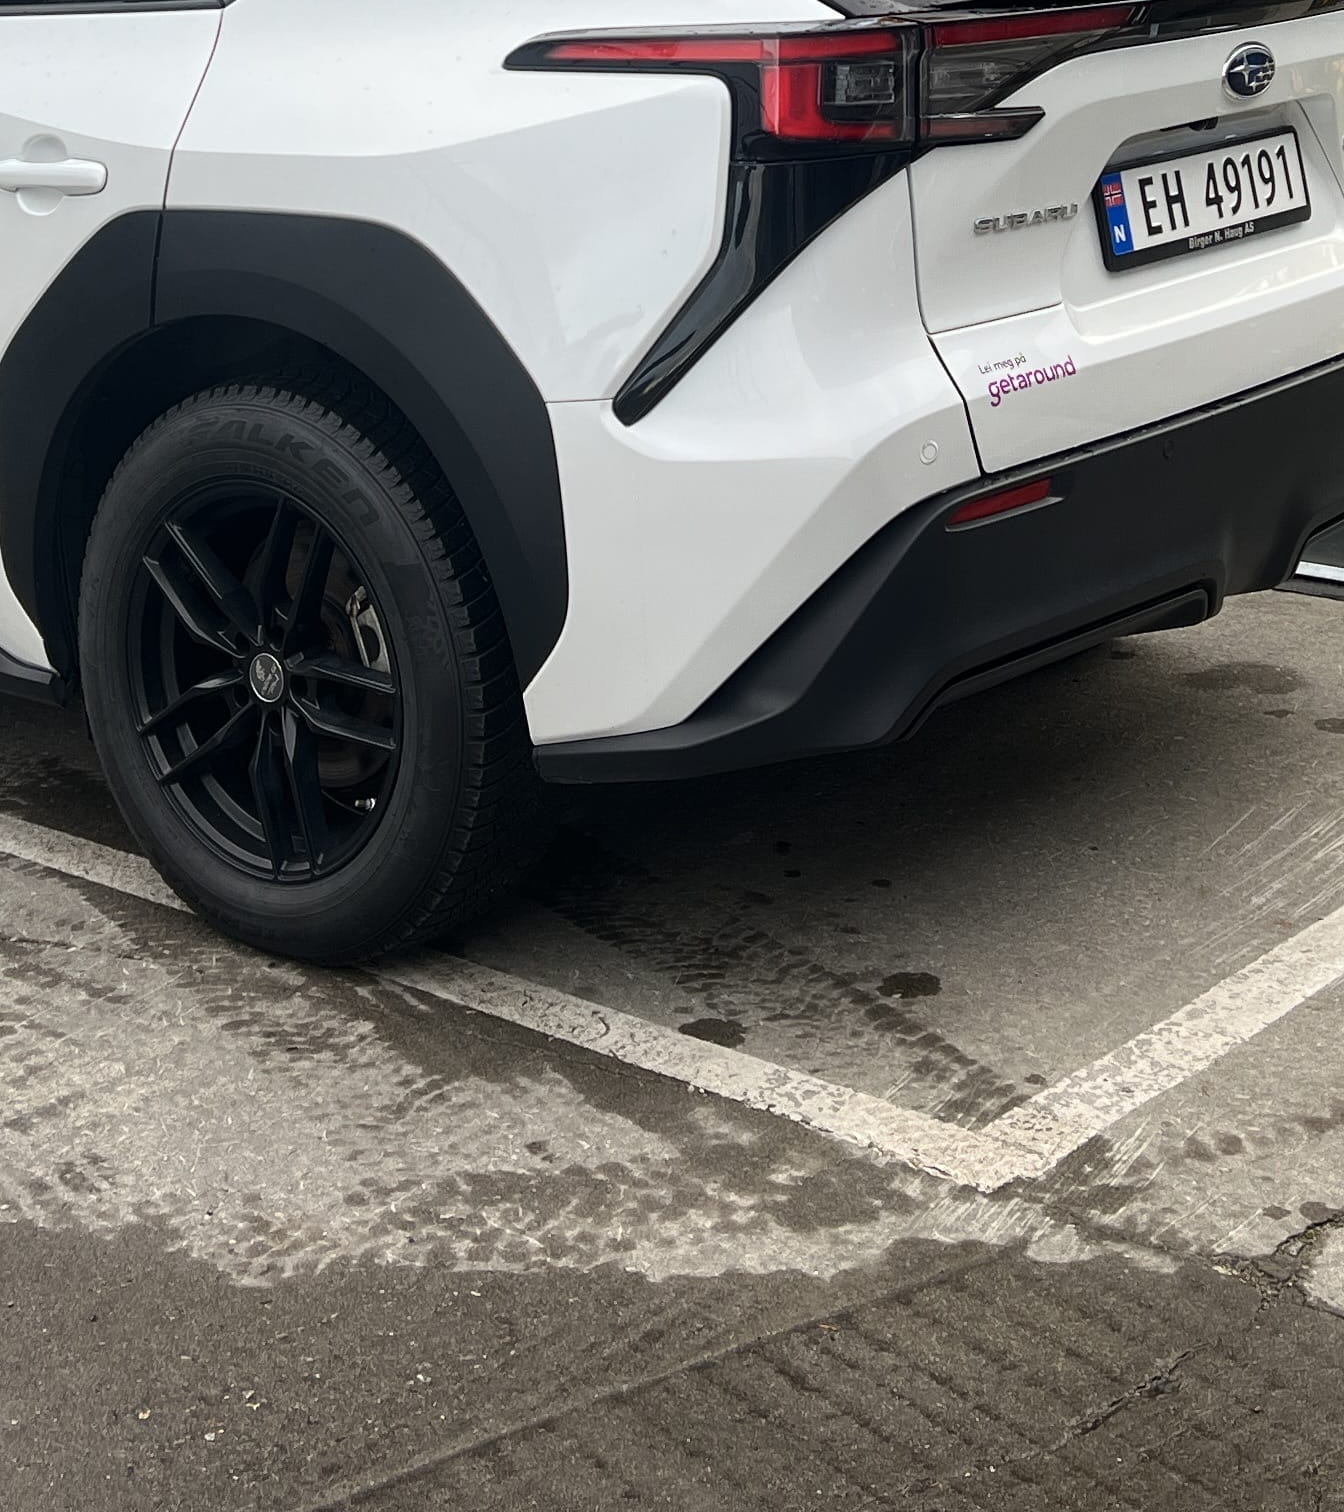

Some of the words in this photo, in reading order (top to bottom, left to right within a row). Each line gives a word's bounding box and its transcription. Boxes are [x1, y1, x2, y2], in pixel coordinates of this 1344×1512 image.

[1137, 169, 1191, 237] EH
[1205, 144, 1294, 219] 49191
[973, 202, 1078, 236] SUBARU
[1113, 223, 1126, 244] N
[1189, 234, 1213, 249] Birger
[1244, 221, 1255, 234] AS
[977, 362, 993, 375] Lei
[993, 358, 1015, 370] meg
[1014, 351, 1027, 368] på
[988, 354, 1077, 408] getaround
